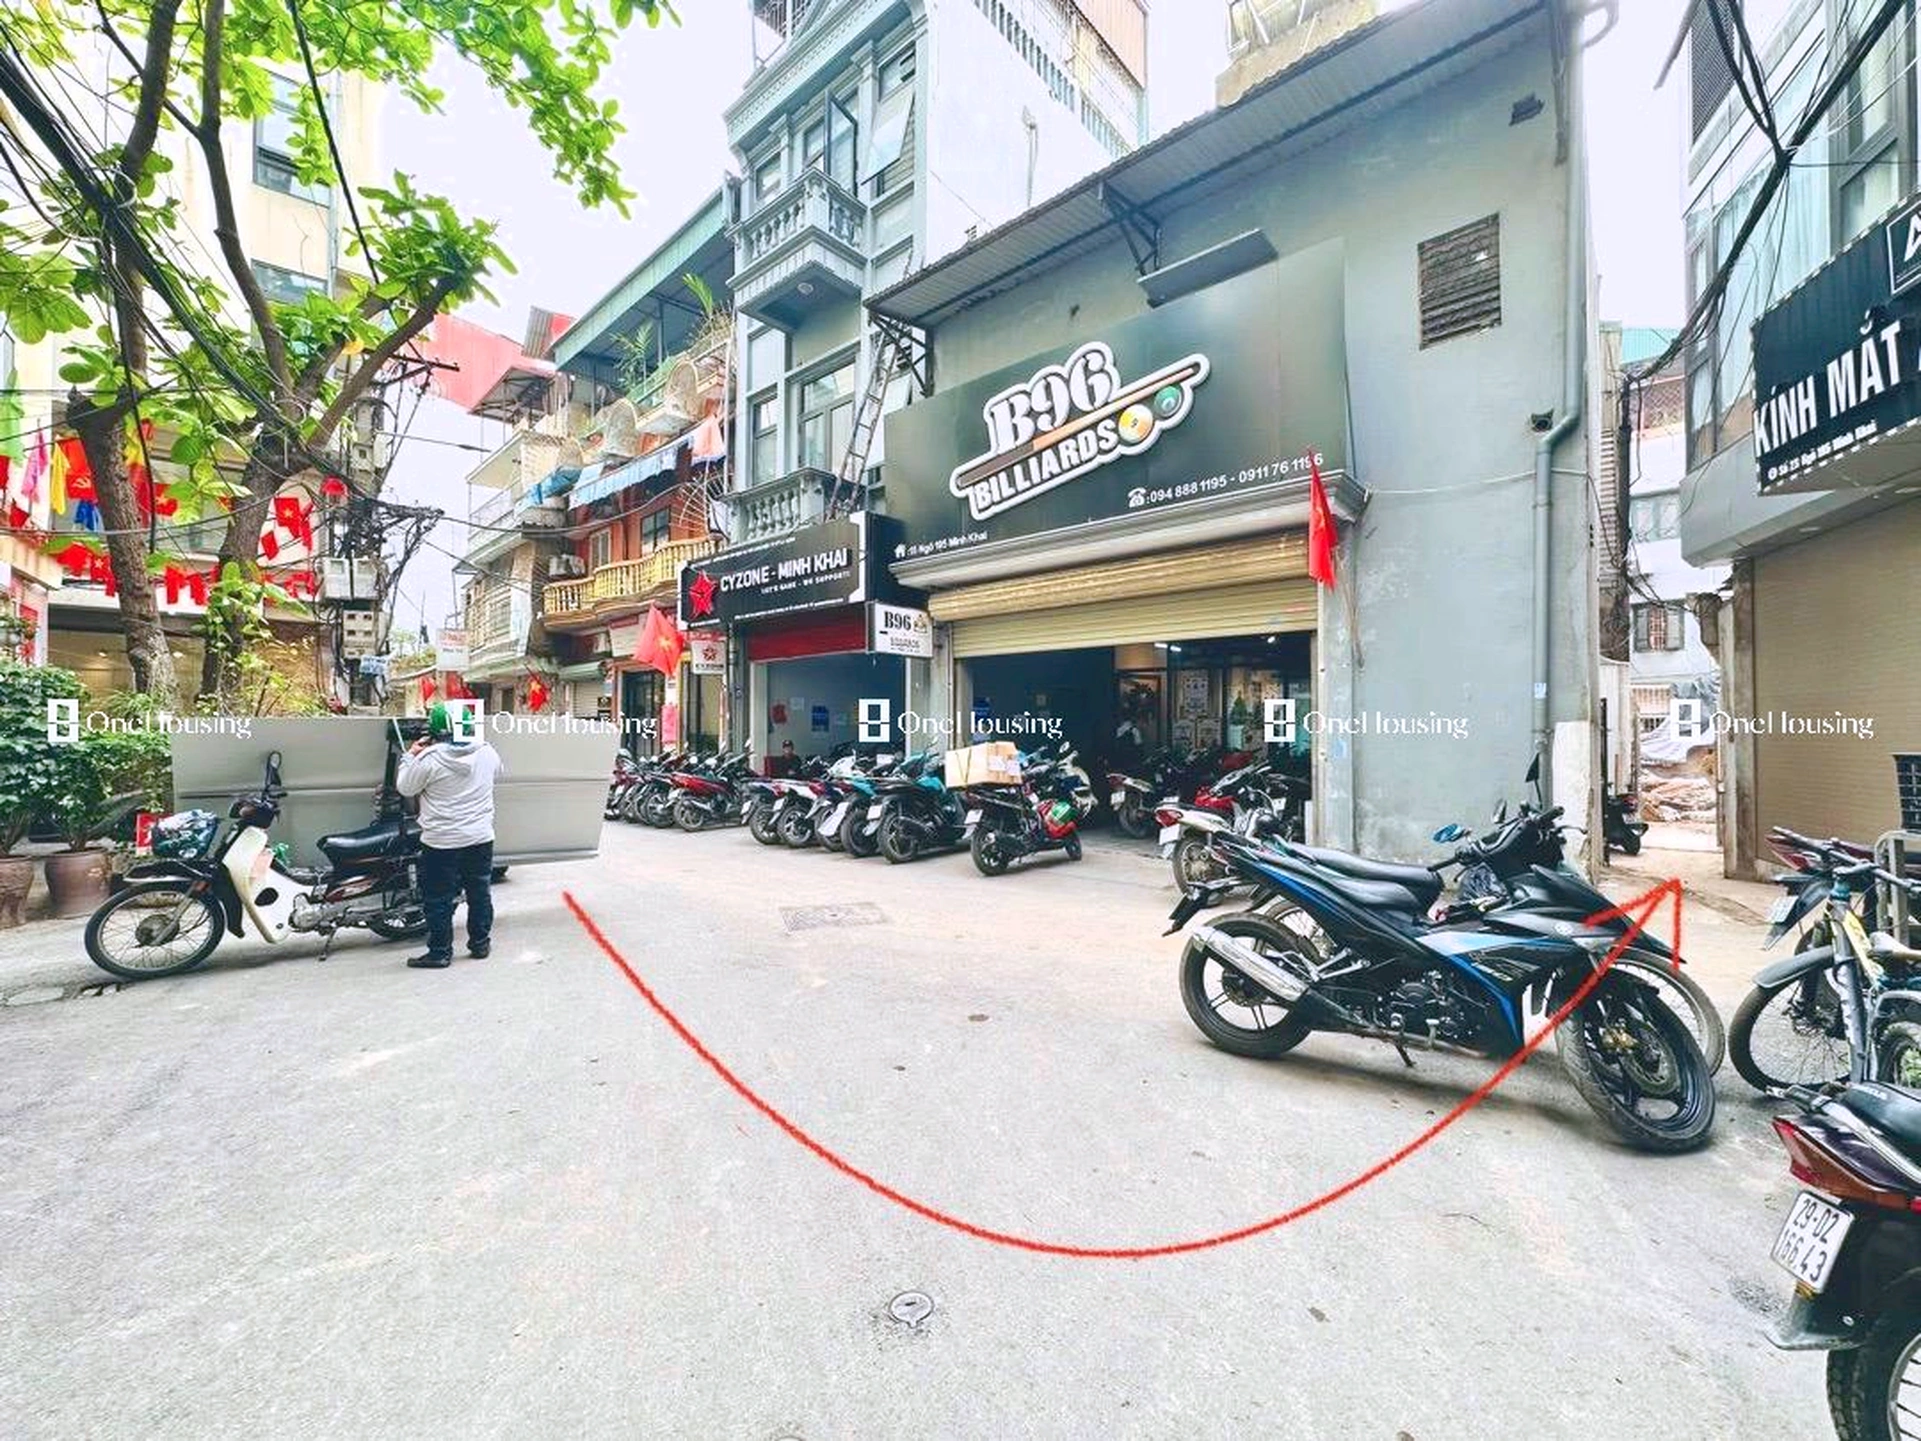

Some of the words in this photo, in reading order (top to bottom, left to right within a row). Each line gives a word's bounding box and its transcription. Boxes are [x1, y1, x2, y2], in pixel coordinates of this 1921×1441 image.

[990, 350, 1112, 451] B96
[1753, 375, 1817, 457] KÍNH
[1826, 310, 1901, 418] MẮT
[974, 418, 1118, 510] BILLIARDS
[1174, 481, 1198, 498] 888
[1200, 475, 1227, 492] 1195
[1239, 467, 1269, 483] 0911
[1272, 461, 1289, 476] 76
[720, 565, 770, 592] CYZONE
[778, 557, 811, 580] MINH
[814, 548, 847, 572] KHAI
[884, 611, 911, 631] B96
